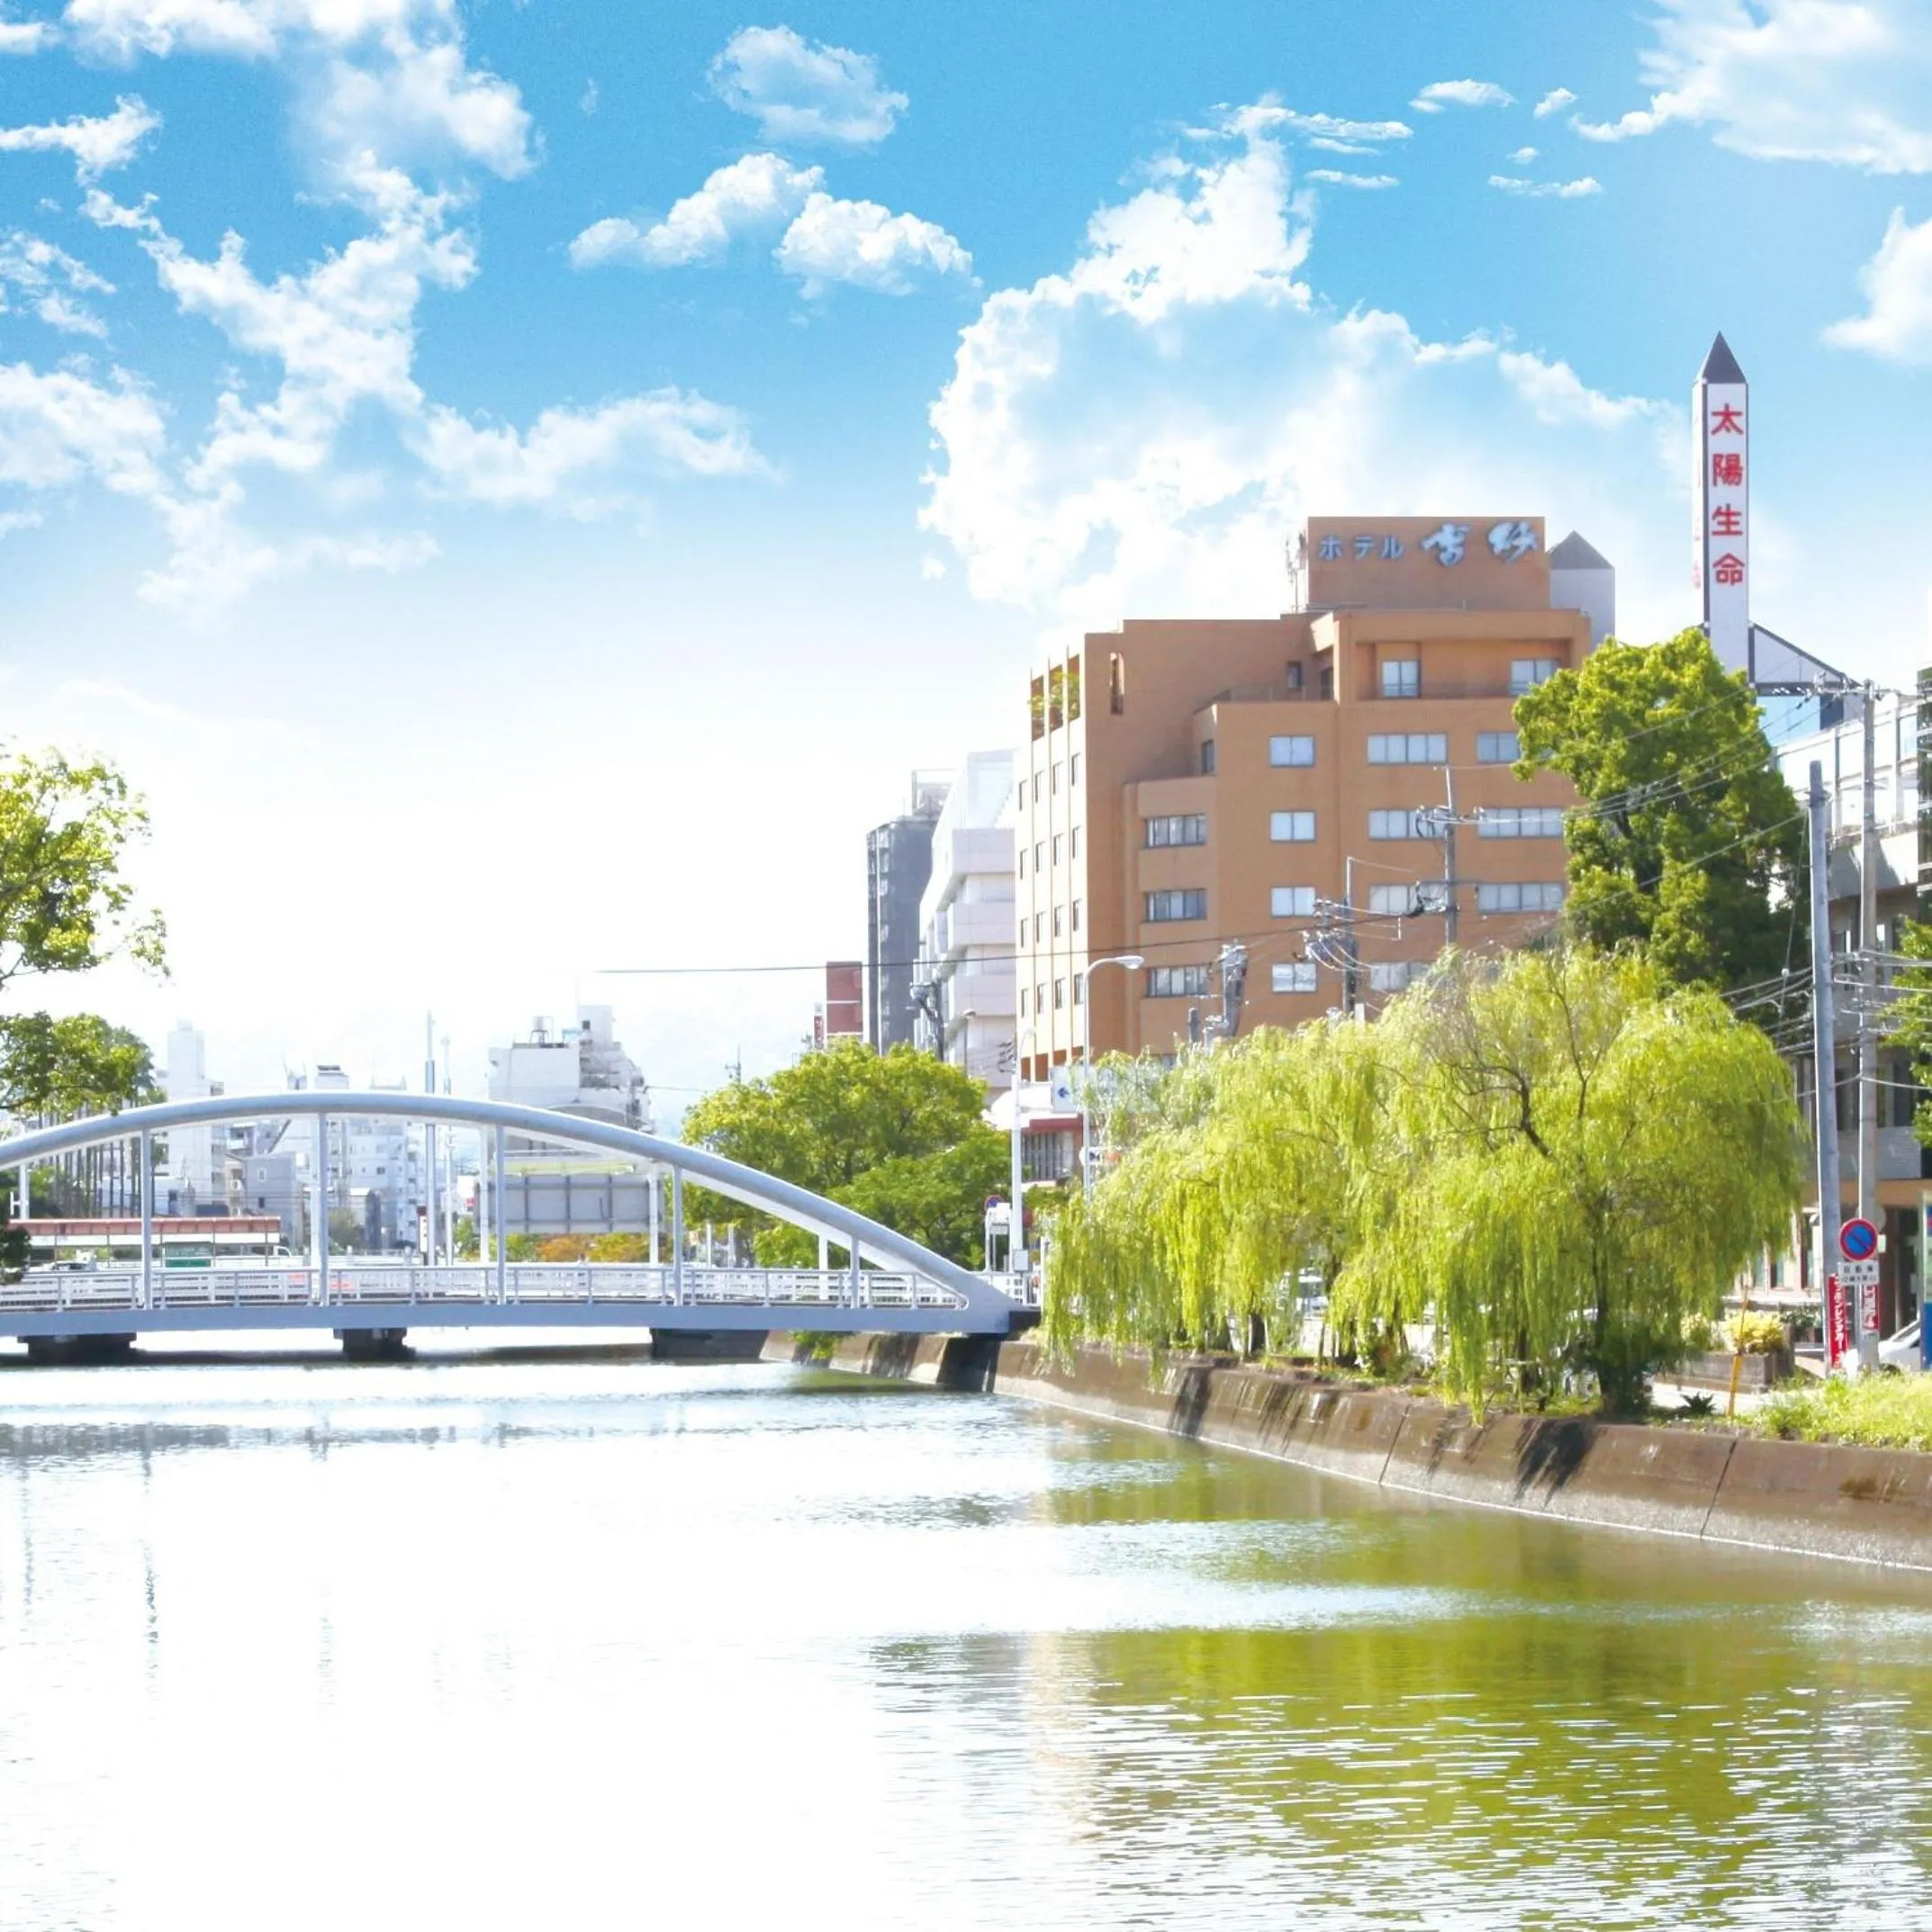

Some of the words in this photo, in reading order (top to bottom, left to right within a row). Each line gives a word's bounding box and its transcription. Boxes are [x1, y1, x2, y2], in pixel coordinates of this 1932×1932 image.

[1711, 403, 1745, 585] 太陽生命
[1318, 535, 1404, 560] ホテル
